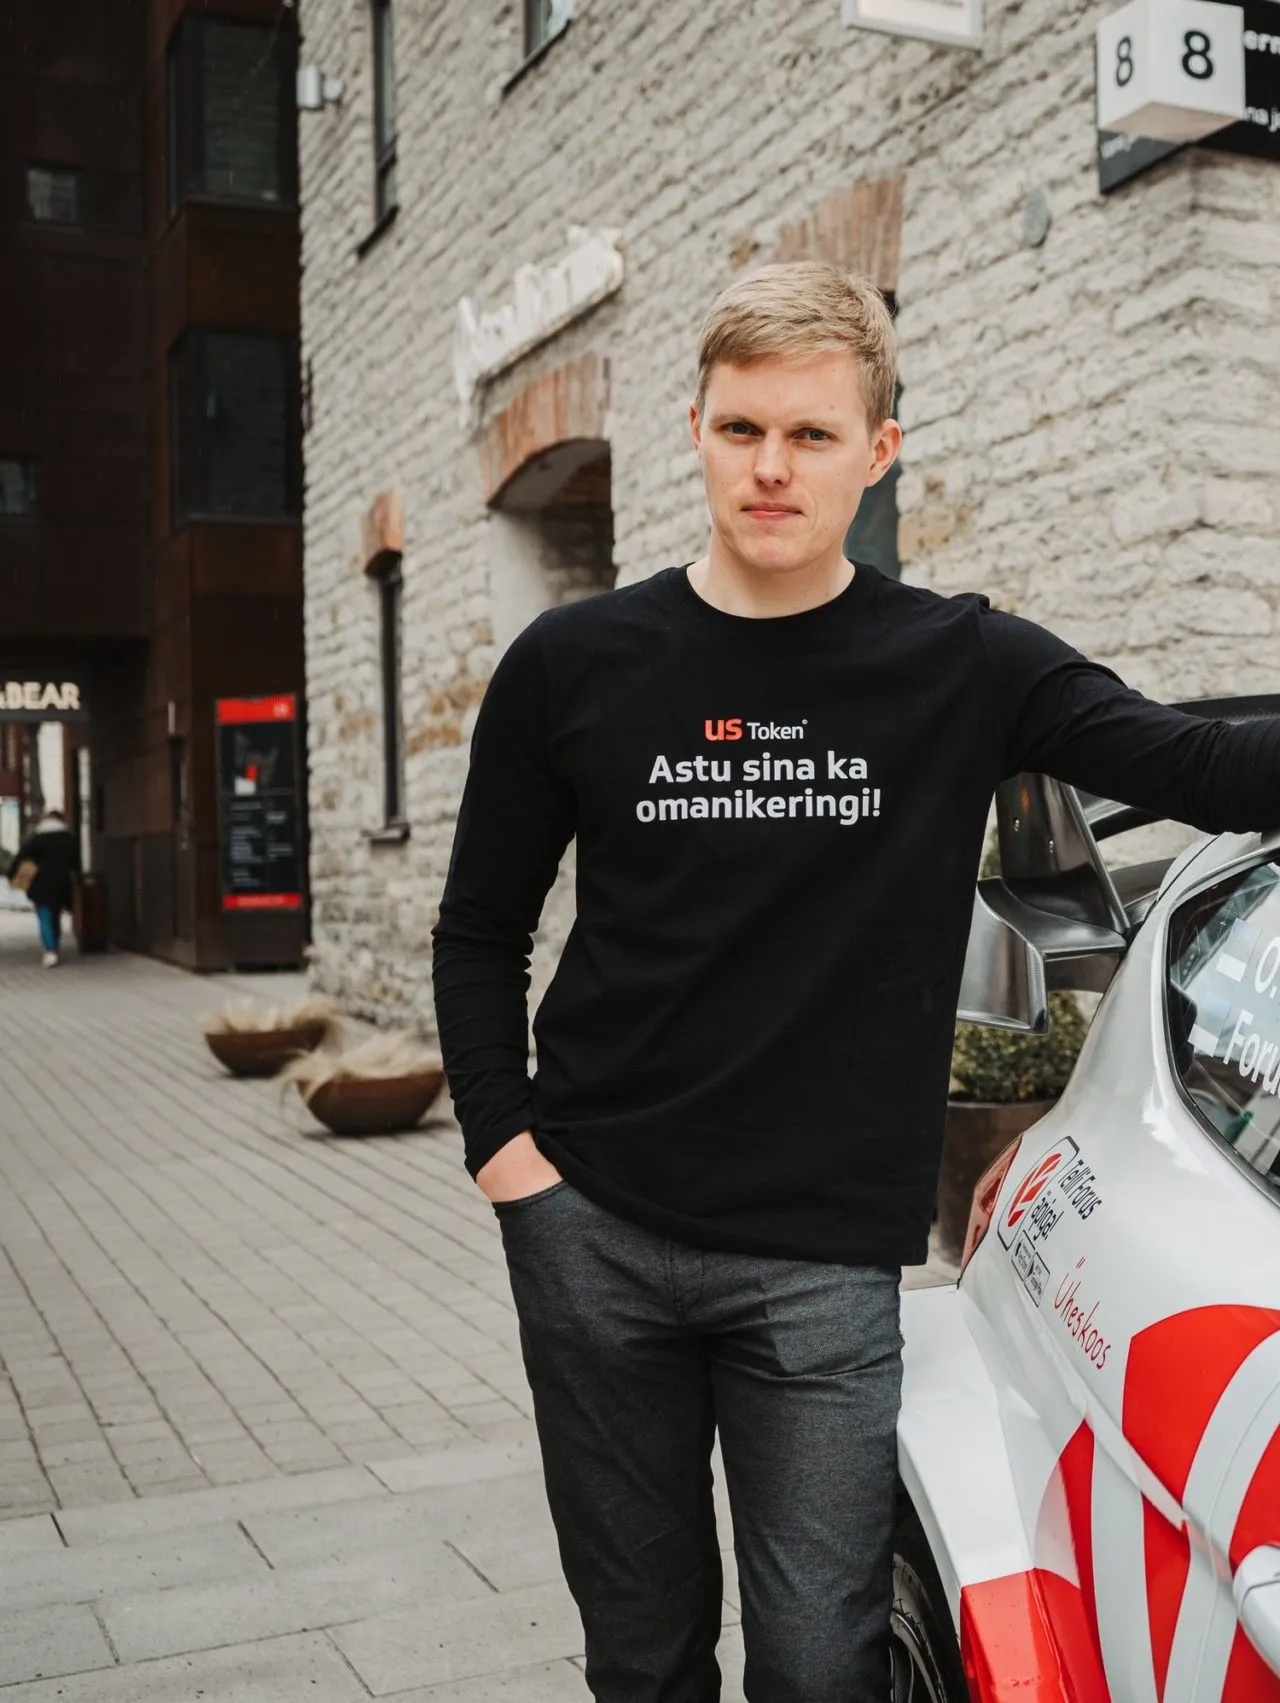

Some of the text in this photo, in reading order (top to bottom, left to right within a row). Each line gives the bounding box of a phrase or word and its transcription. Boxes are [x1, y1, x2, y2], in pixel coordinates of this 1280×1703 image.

[1116, 36, 1133, 87] 8
[1182, 29, 1214, 80] 8
[649, 750, 868, 783] Astu sina ka
[636, 788, 881, 825] omanikeringi!
[1058, 1159, 1102, 1220] Telli Forus
[1054, 1256, 1111, 1370] Üheskoos
